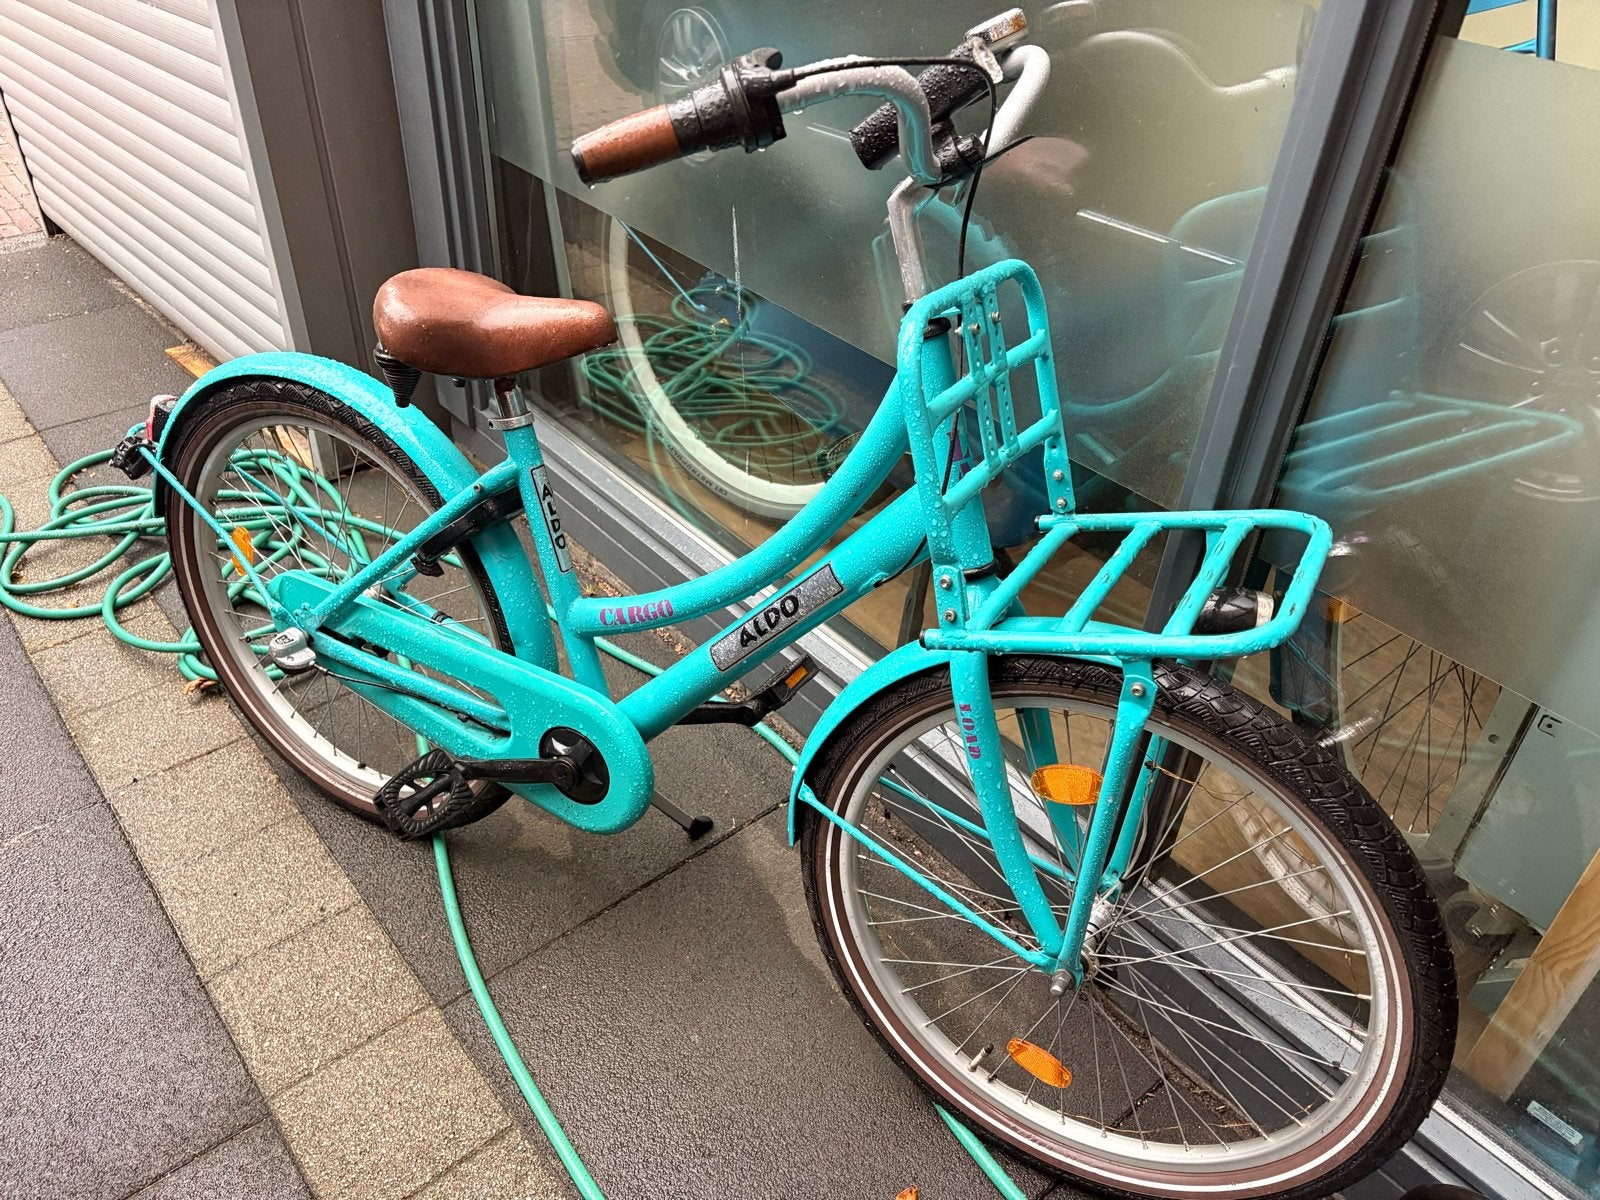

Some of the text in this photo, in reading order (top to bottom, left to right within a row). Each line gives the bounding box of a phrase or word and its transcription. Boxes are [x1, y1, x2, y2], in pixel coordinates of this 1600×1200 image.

[542, 483, 566, 550] ALDO
[599, 599, 674, 626] CARGO
[740, 594, 800, 648] ALDO
